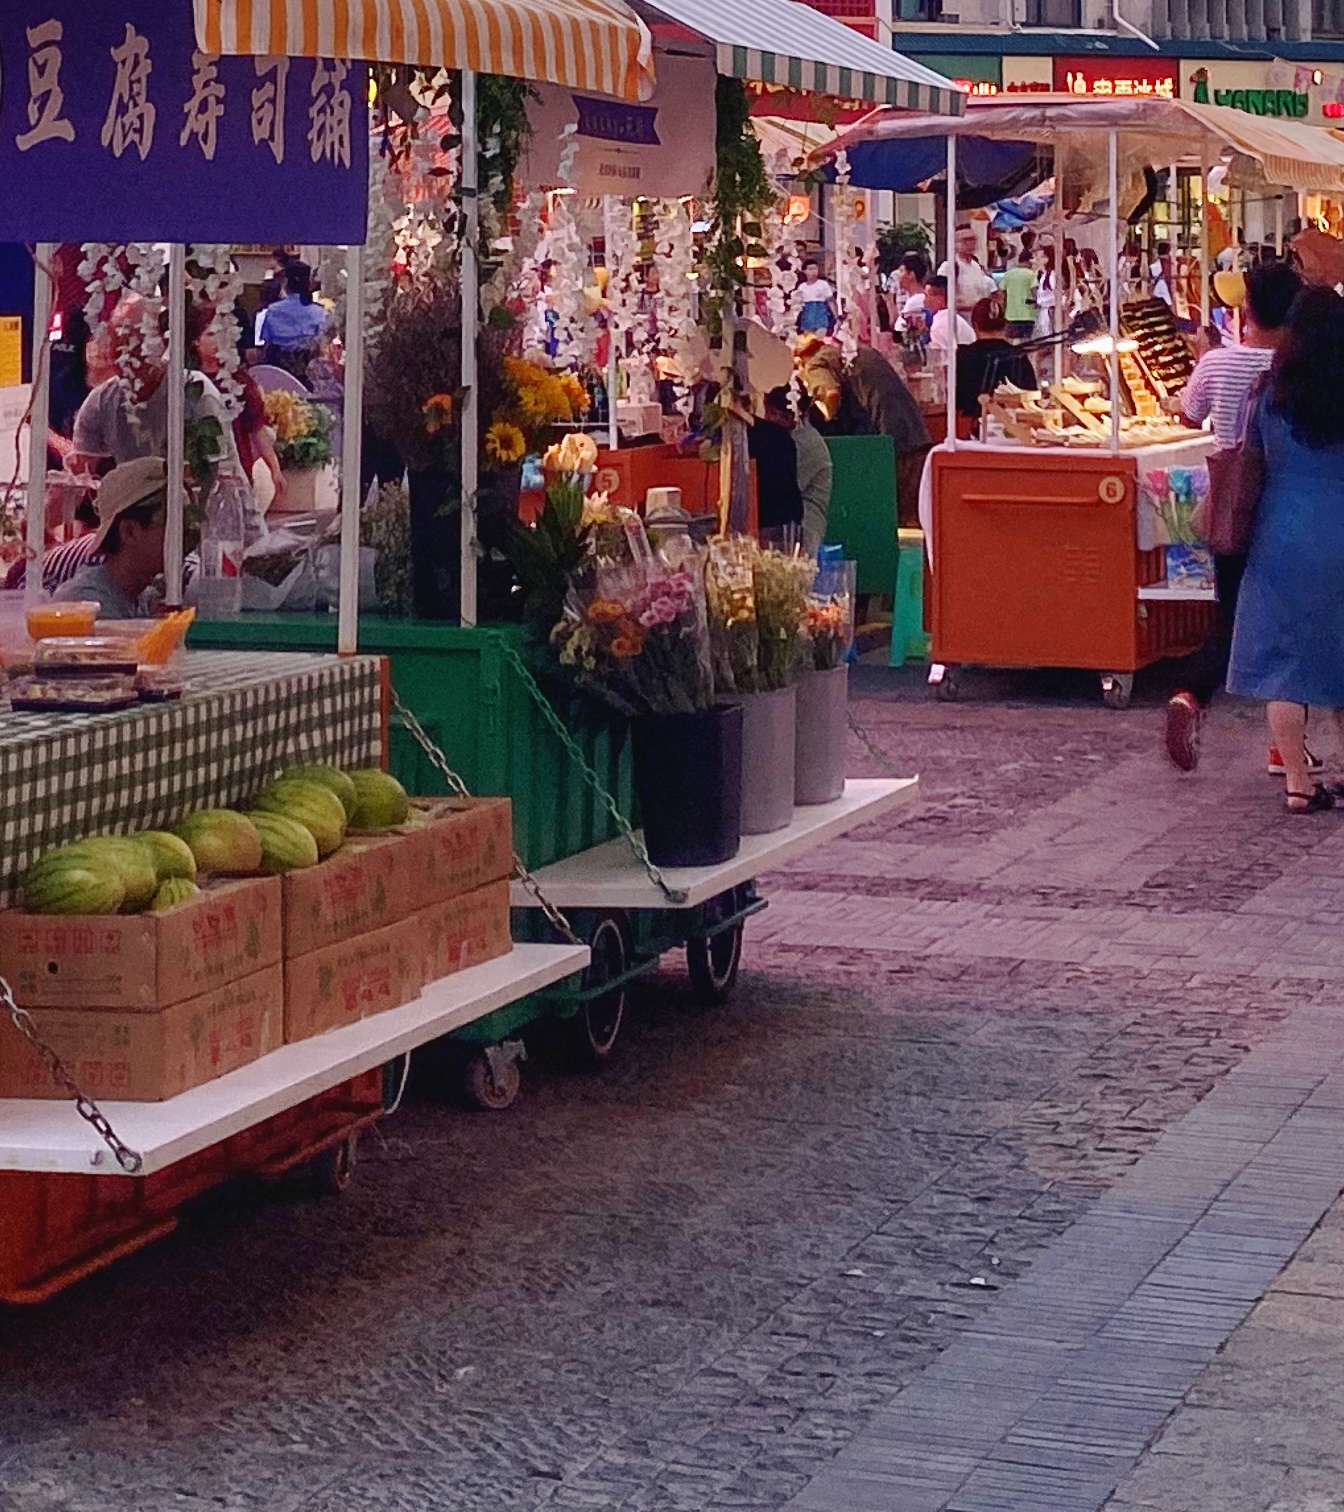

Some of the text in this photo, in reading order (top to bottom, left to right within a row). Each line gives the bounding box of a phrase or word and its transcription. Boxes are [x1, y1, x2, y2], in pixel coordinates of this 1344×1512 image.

[15, 18, 353, 170] 豆腐寿司铺
